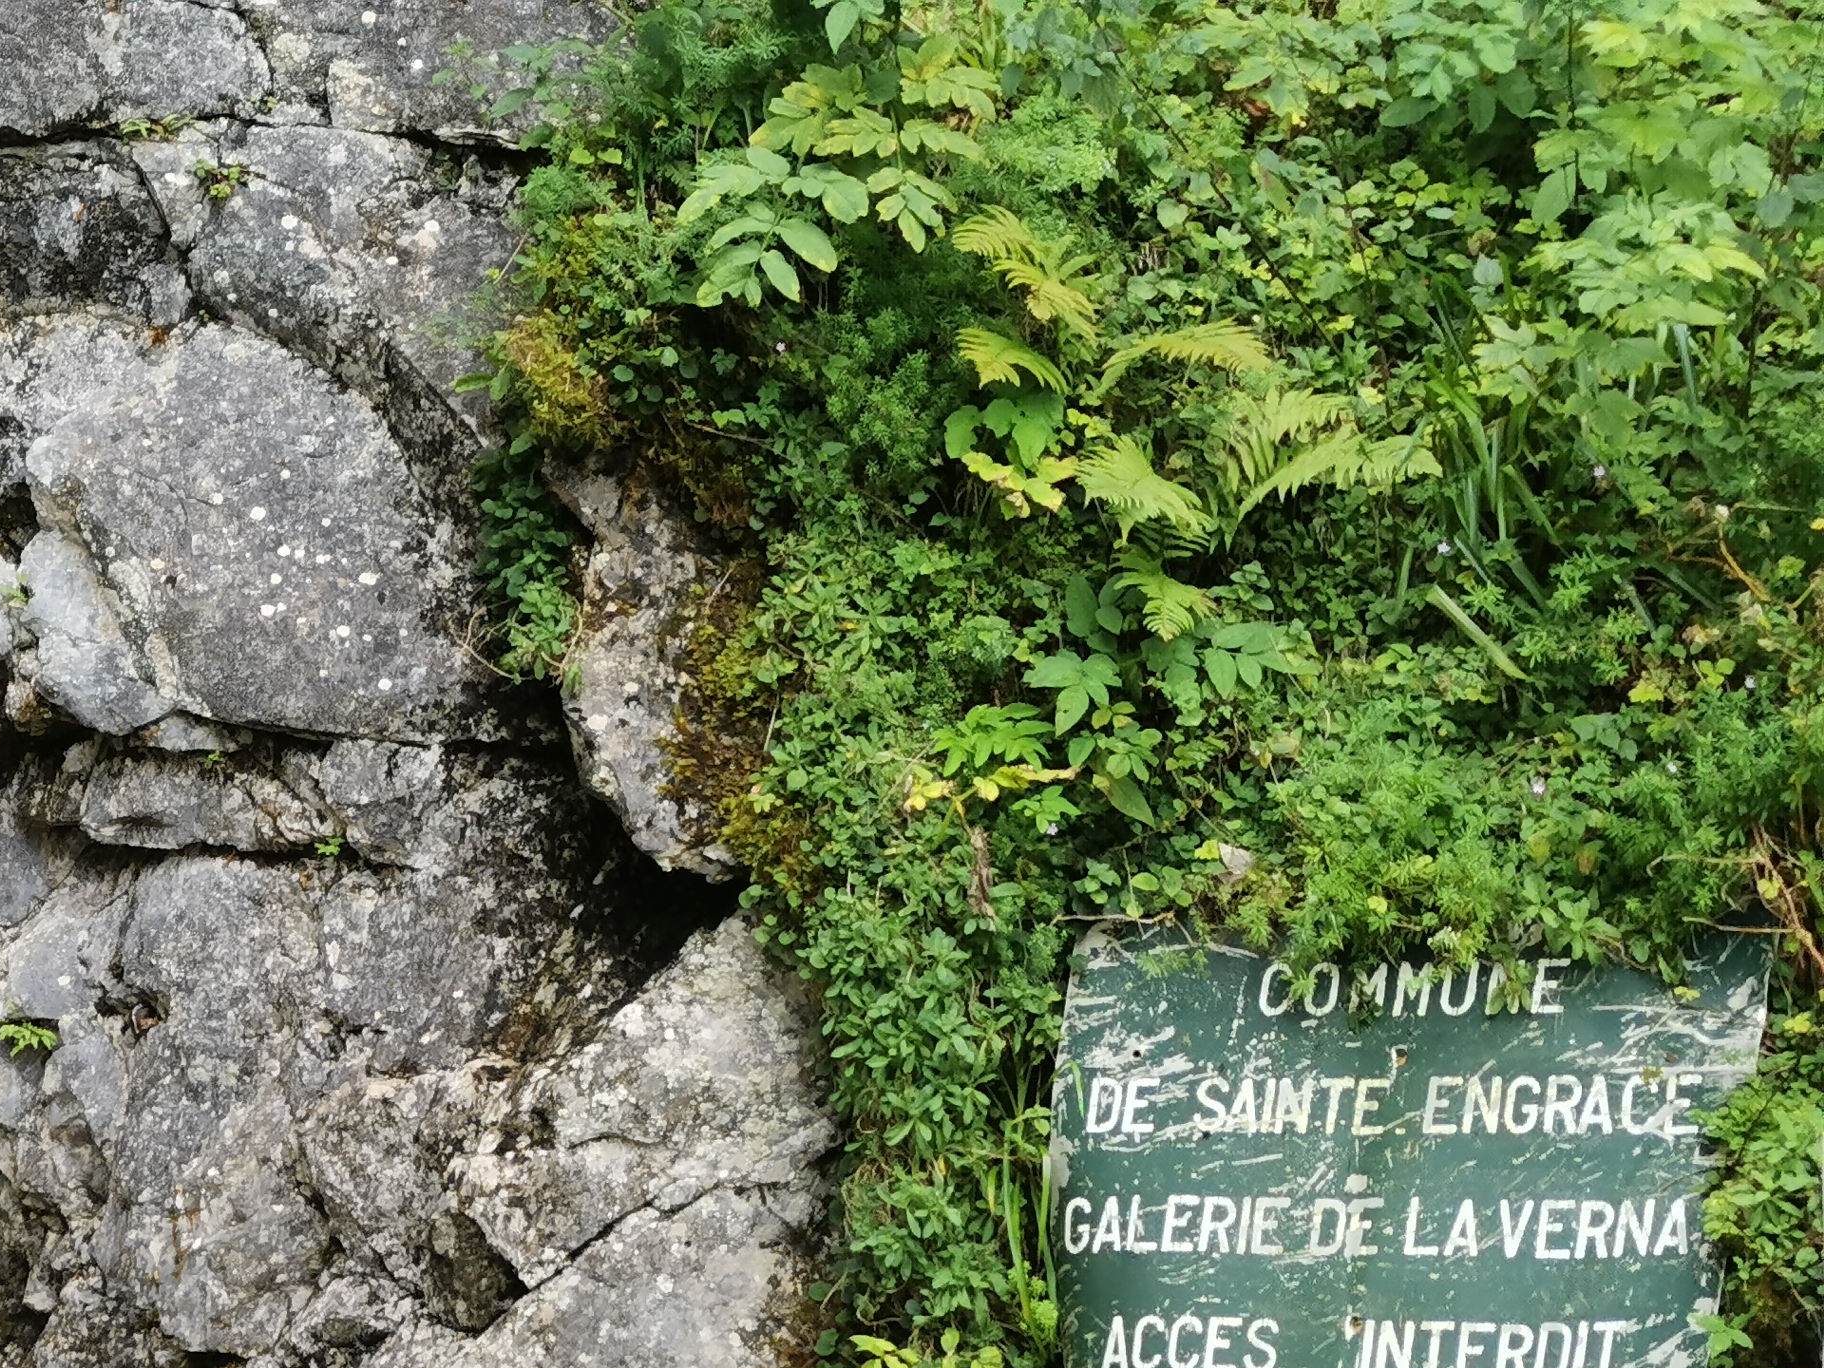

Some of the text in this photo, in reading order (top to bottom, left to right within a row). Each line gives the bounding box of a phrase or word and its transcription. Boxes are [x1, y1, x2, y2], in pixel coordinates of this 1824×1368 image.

[1259, 958, 1571, 1017] COMMUNE
[1086, 1077, 1160, 1133] DE
[1422, 1073, 1703, 1136] ENGRACE
[1064, 1195, 1689, 1260] GALERIE DE LA VERNA
